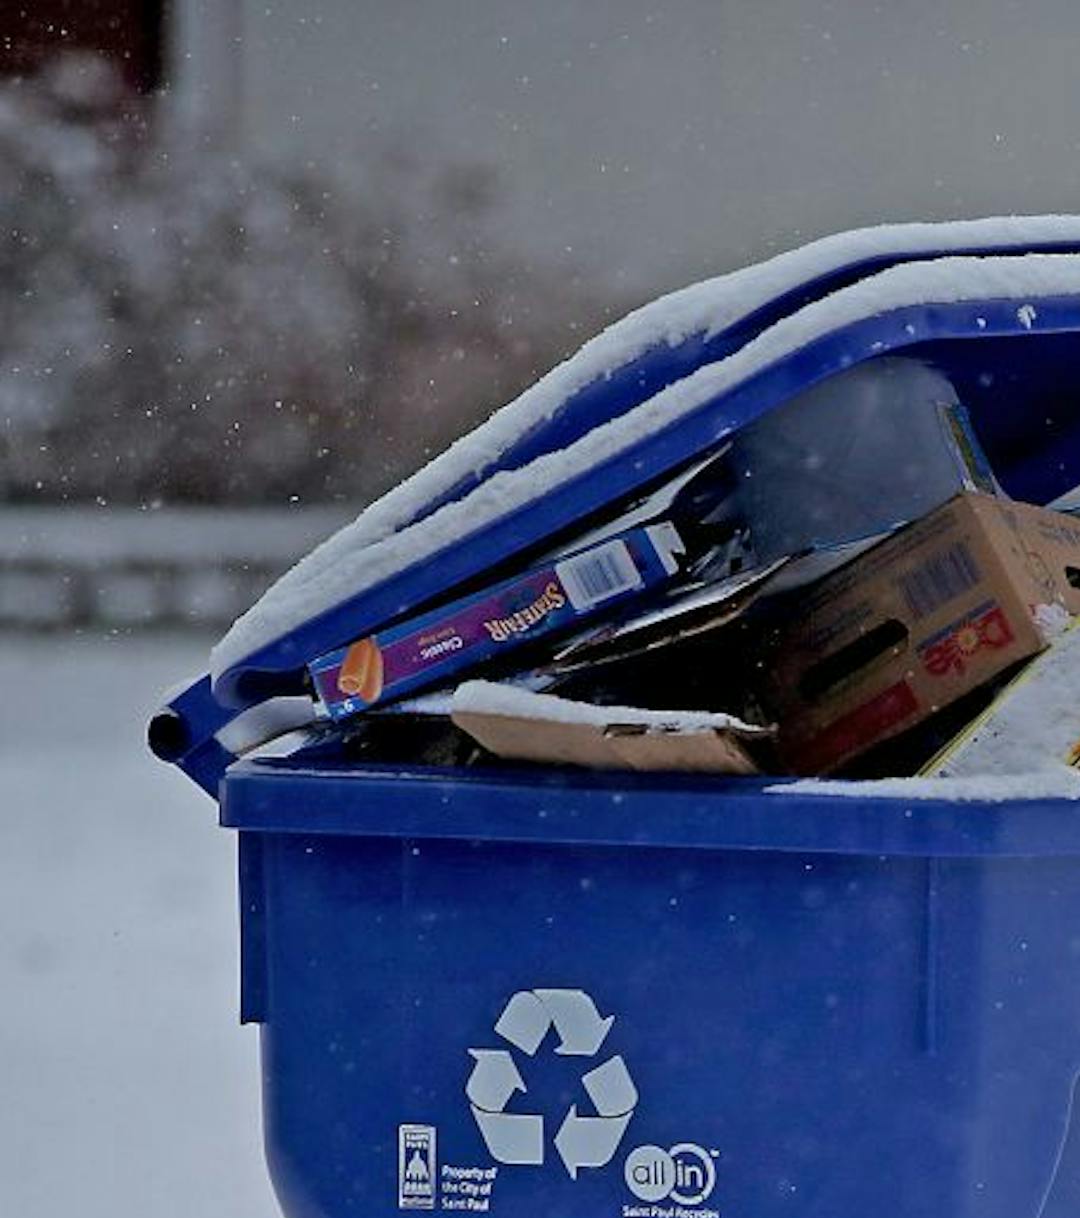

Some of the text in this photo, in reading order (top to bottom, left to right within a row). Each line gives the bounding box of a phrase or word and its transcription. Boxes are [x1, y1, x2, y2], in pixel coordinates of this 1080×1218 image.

[441, 1165, 498, 1182] Property of
[632, 1159, 703, 1188] all in
[441, 1182, 493, 1197] the City of
[441, 1197, 467, 1210] Saint
[468, 1198, 490, 1211] Paul
[622, 1205, 650, 1218] Saint
[650, 1206, 674, 1218] Paul
